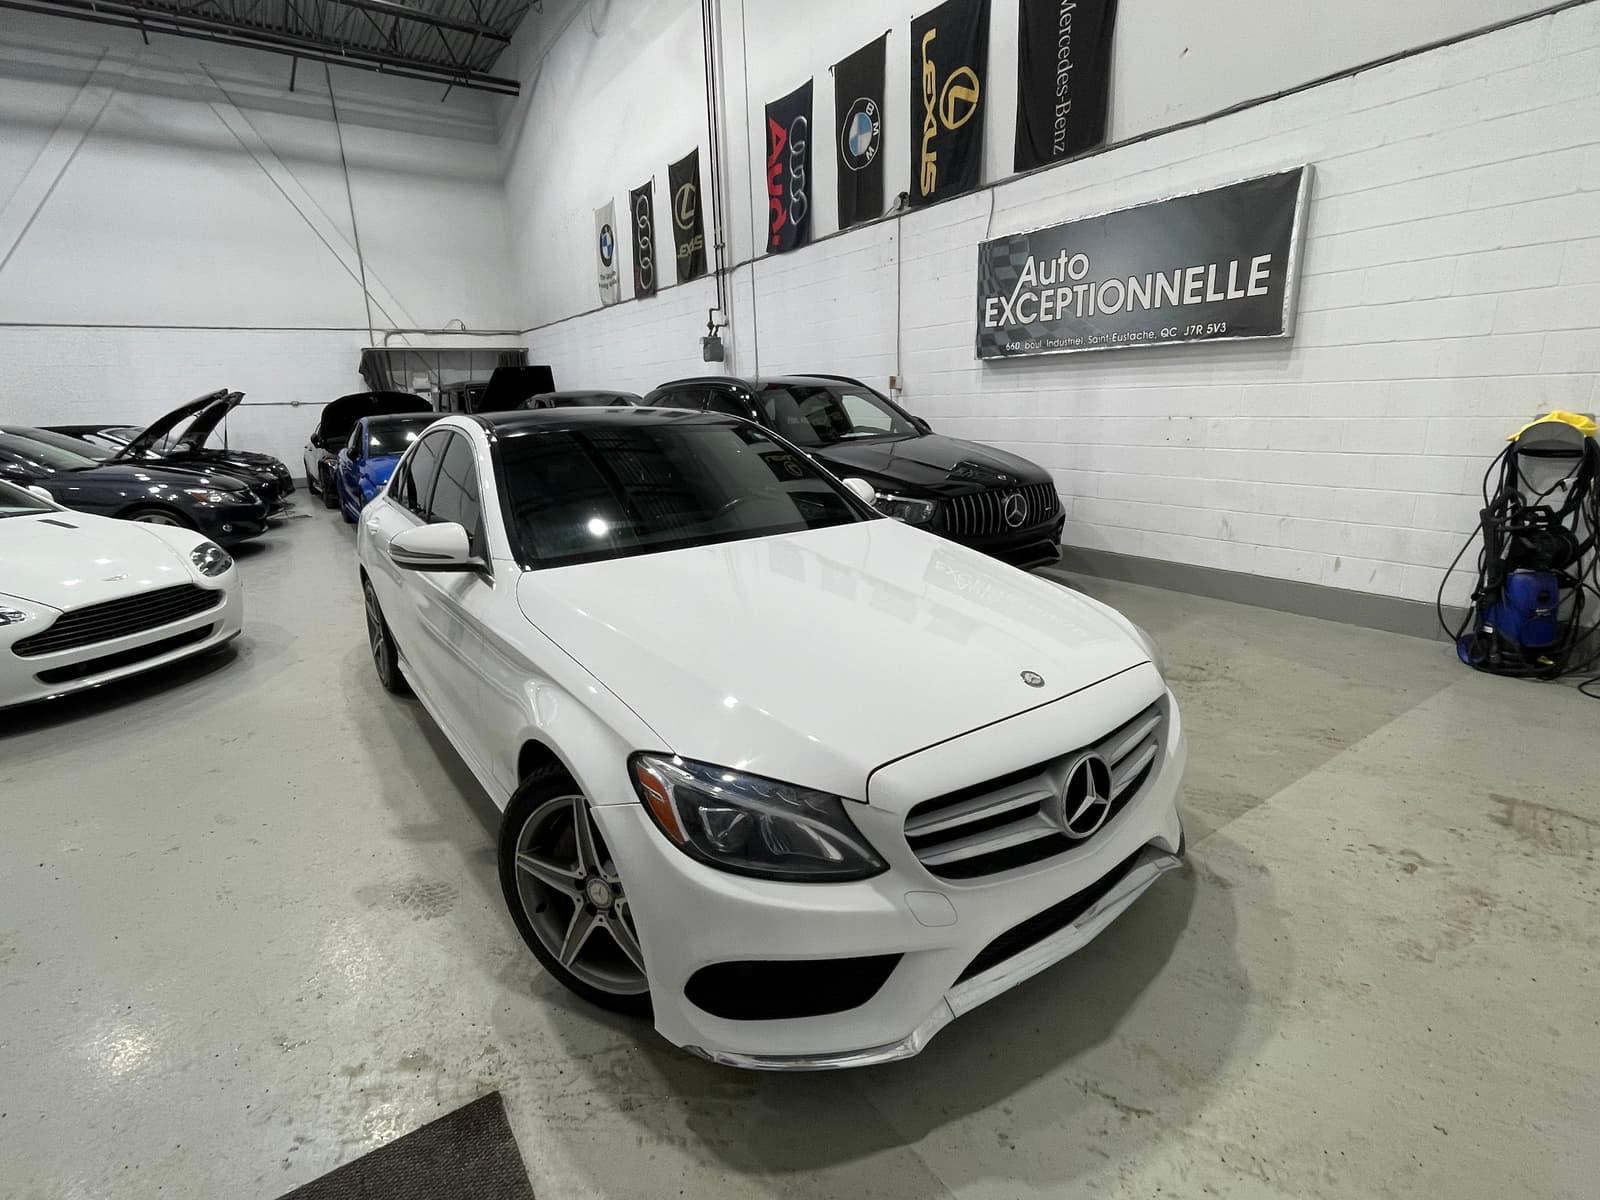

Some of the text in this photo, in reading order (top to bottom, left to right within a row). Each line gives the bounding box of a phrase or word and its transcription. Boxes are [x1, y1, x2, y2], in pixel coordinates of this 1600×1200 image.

[1053, 0, 1077, 155] Mercedes-Benz
[865, 102, 880, 161] BMW
[921, 28, 937, 197] LEXUS
[984, 254, 1273, 329] EXCEPTIONNELLE
[1015, 247, 1090, 290] Auto
[1160, 327, 1178, 339] QC
[1184, 324, 1204, 336] J7R
[1206, 322, 1227, 335] 5V3
